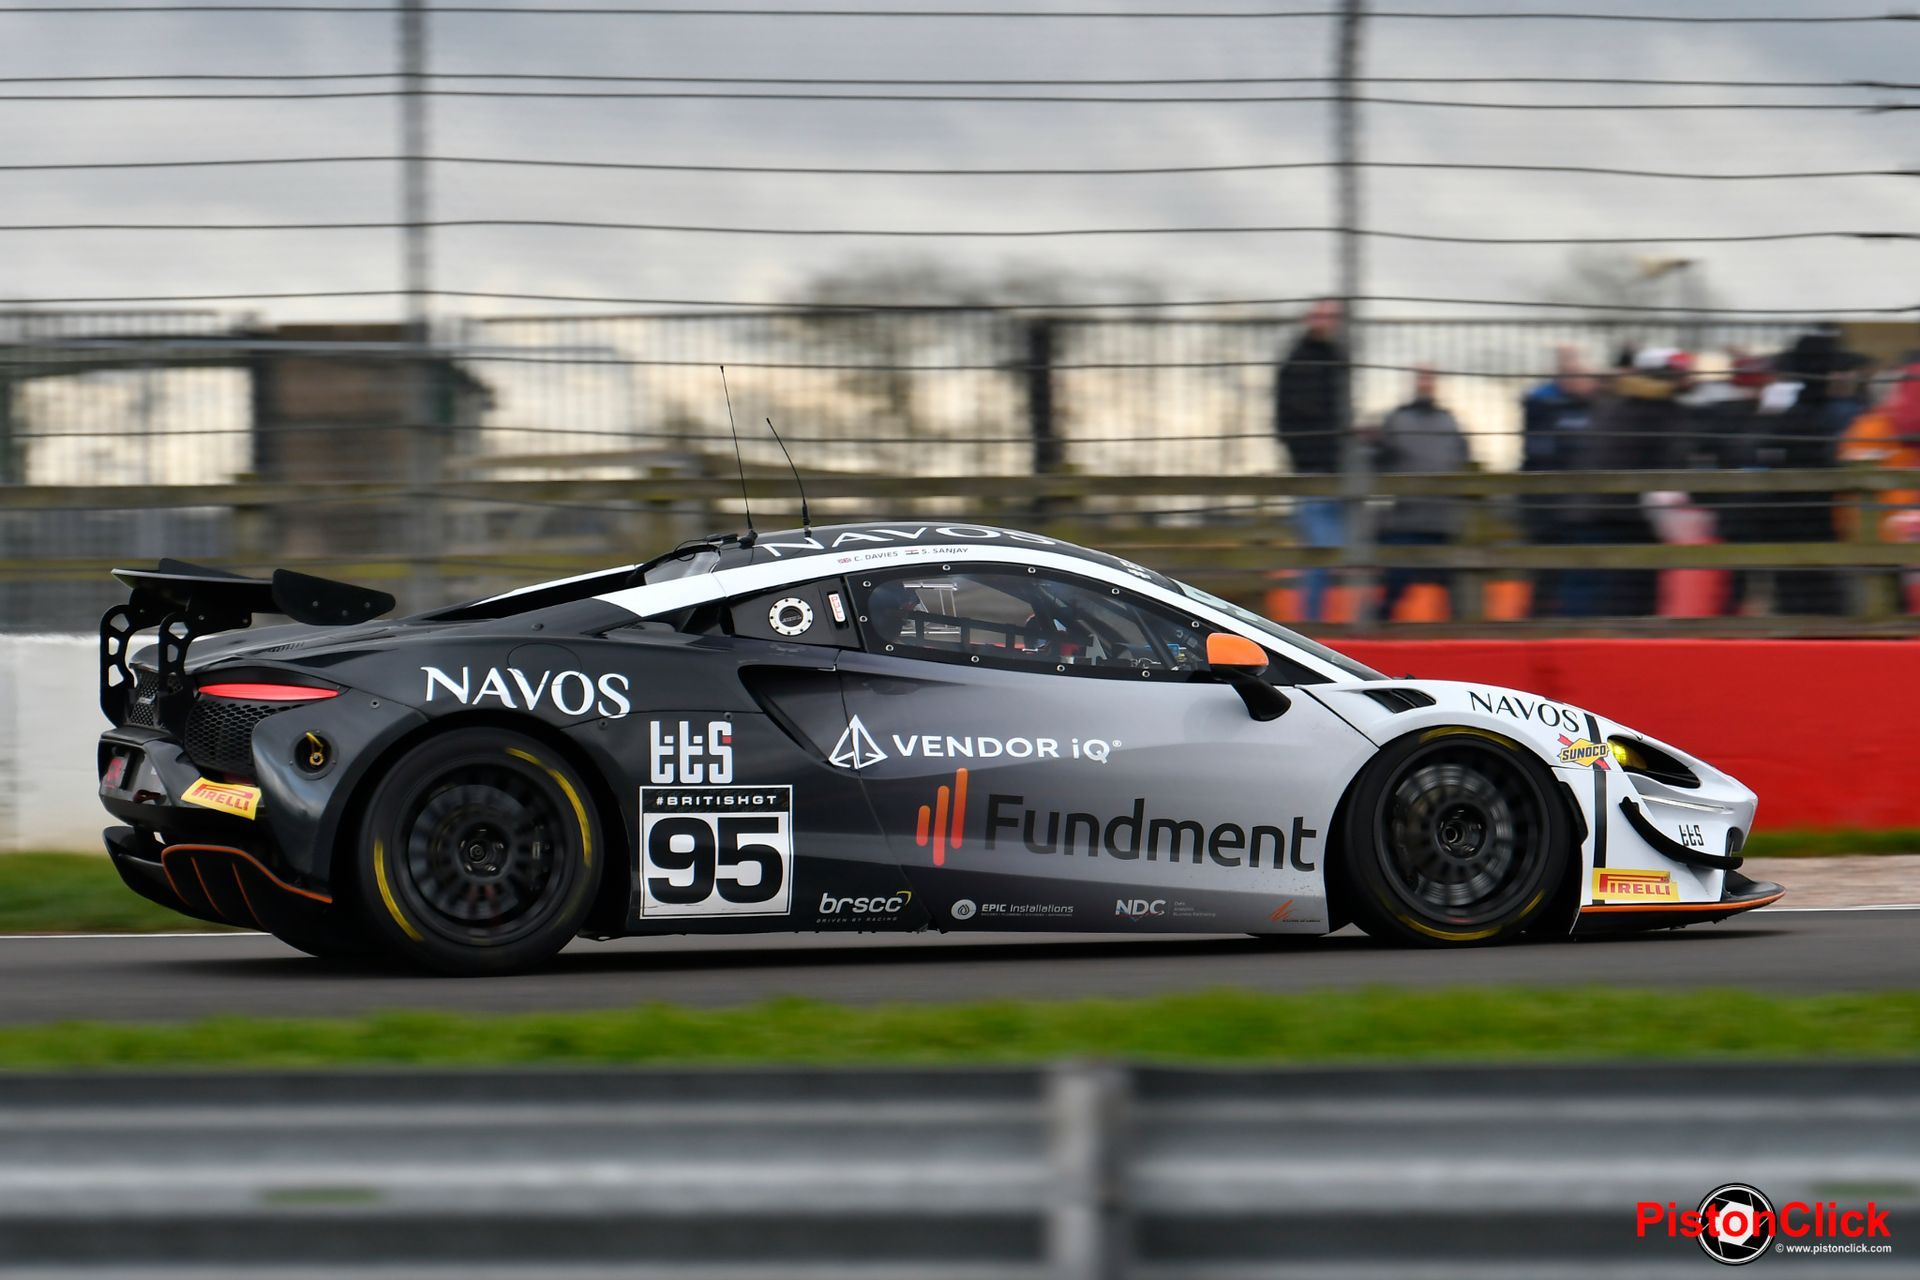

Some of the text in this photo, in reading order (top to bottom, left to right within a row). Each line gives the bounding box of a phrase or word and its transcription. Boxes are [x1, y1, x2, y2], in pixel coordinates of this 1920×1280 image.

[753, 527, 1057, 557] NAVOS
[865, 551, 898, 560] DAVIES
[420, 666, 630, 719] NAVOS
[1467, 690, 1580, 733] NAVOS
[892, 735, 1060, 758] VENDOR
[1561, 745, 1608, 761] SUNOCO
[191, 783, 255, 812] PIRELLI
[656, 796, 777, 806] #BRITISHGT
[984, 794, 1317, 872] Fundment
[648, 817, 783, 904] 95
[1599, 873, 1671, 896] PIRELLI
[819, 892, 903, 914] brscc
[981, 903, 1074, 913] EPIC Installations
[1115, 899, 1167, 916] NDC
